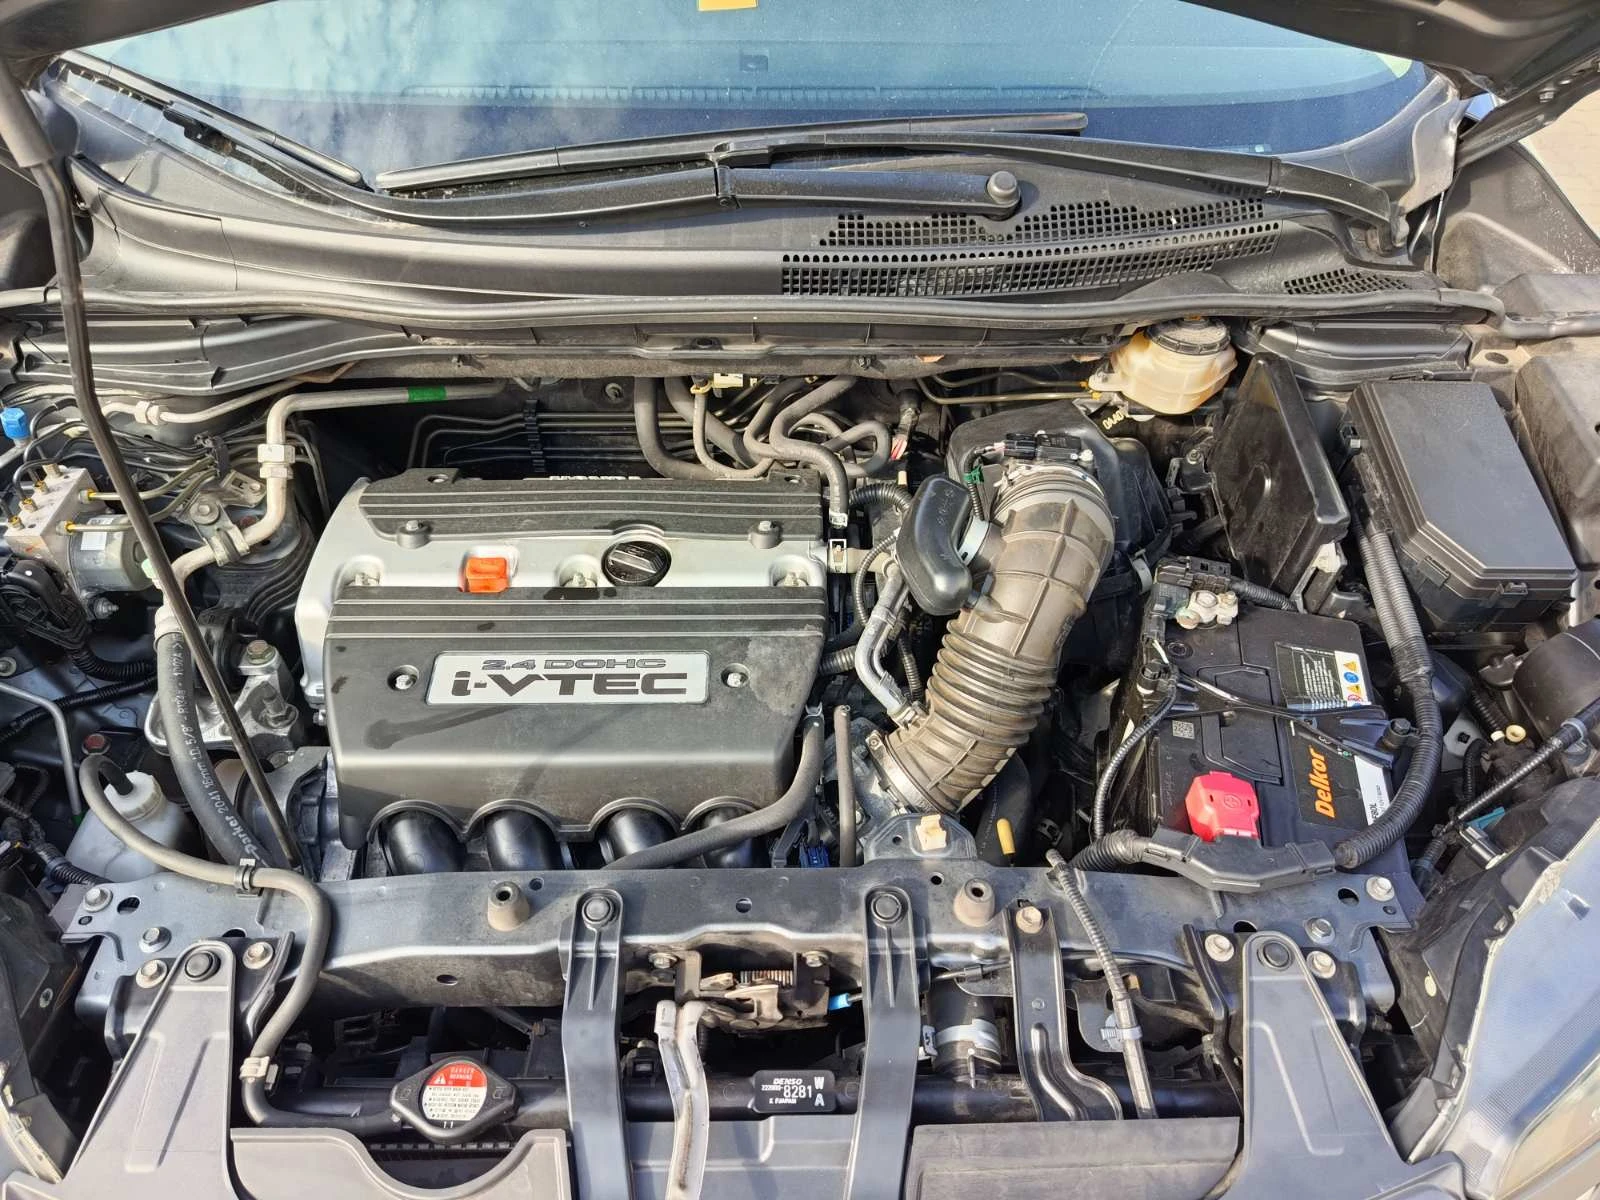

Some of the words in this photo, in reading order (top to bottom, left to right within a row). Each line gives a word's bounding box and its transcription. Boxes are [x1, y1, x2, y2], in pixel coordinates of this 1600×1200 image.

[482, 659, 536, 671] 2.4
[543, 658, 667, 670] DOHC
[451, 670, 688, 697] i-VTEC
[1308, 744, 1336, 818] Delkor
[208, 791, 230, 816] 2041
[772, 1077, 803, 1085] DENSO
[813, 1076, 825, 1090] W
[813, 1092, 825, 1107] A
